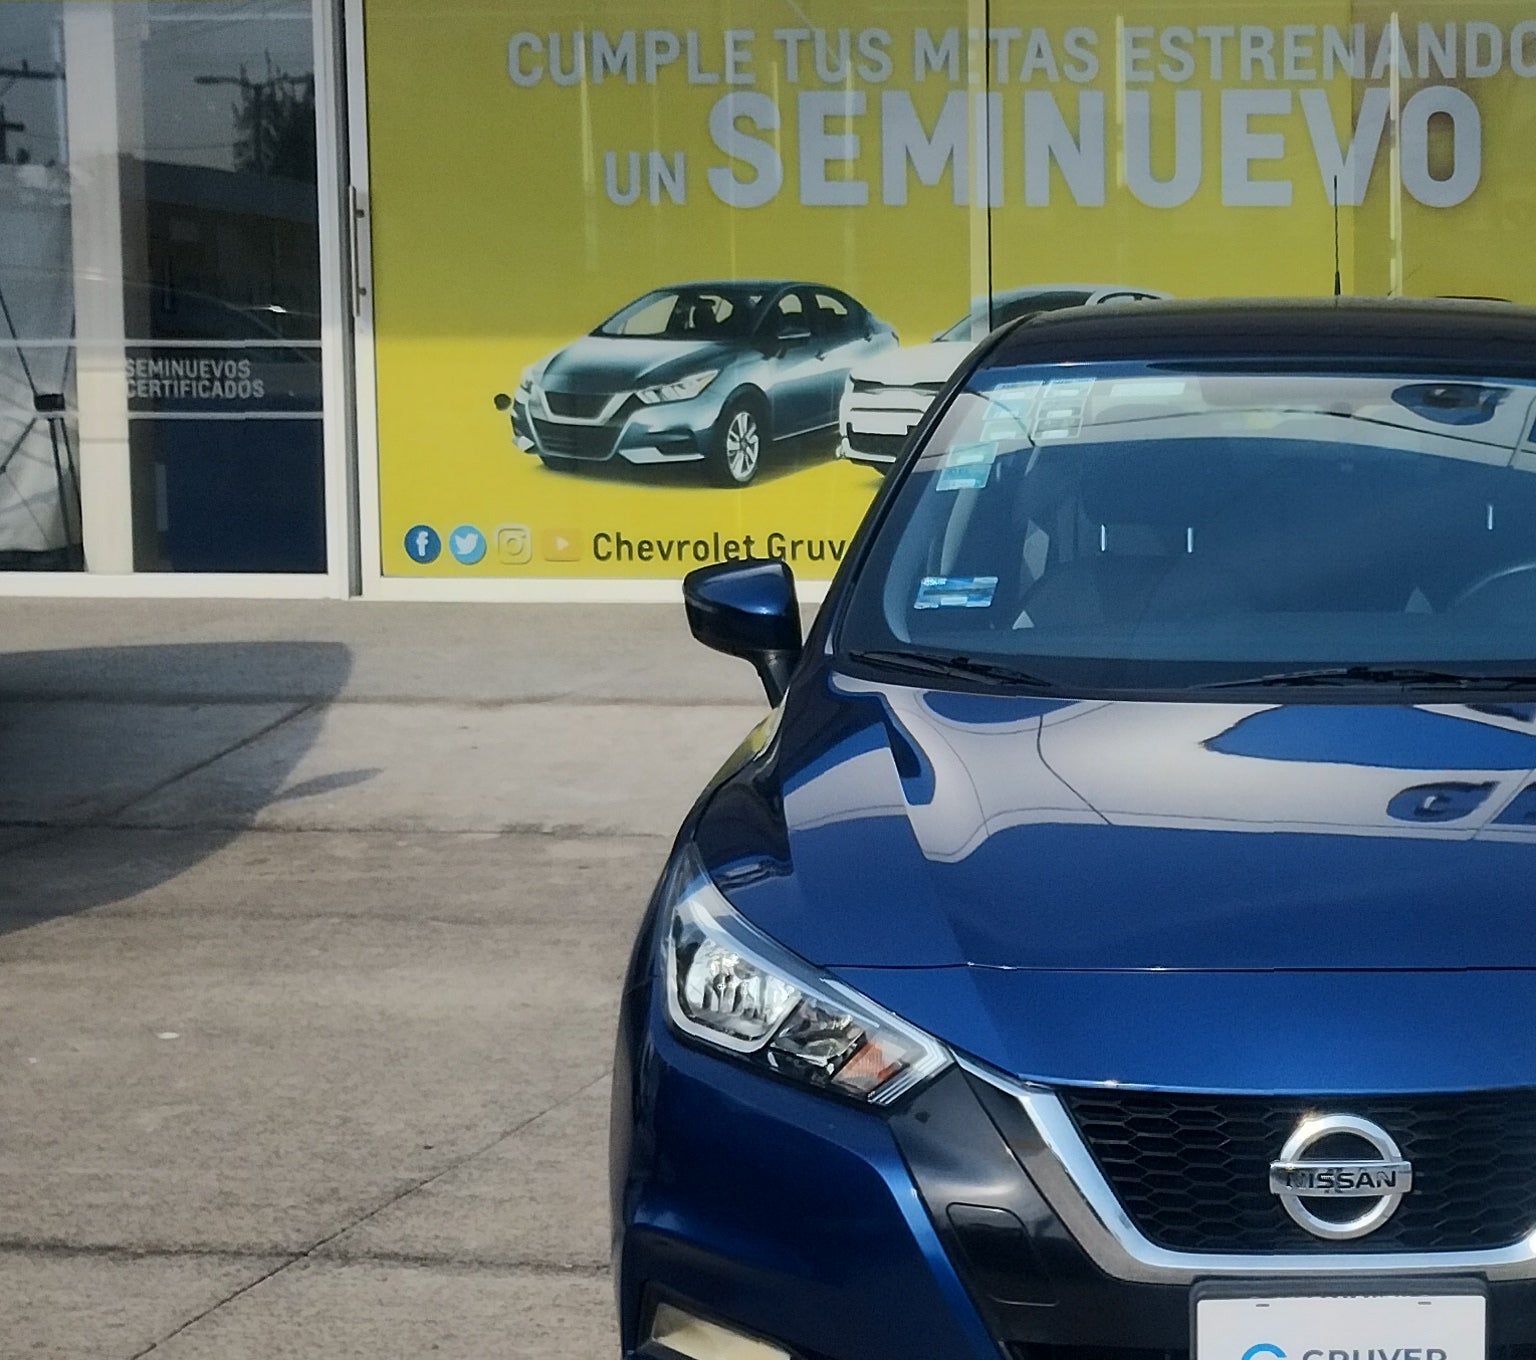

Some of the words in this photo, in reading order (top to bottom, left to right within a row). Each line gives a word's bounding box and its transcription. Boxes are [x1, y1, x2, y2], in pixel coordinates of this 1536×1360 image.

[507, 28, 756, 87] CUMPLE
[774, 27, 893, 84] TUS
[604, 150, 687, 207] UN
[706, 85, 1483, 209] SEMINUEVO
[124, 358, 251, 379] SEMINUEVOS
[127, 379, 265, 399] CERTIFICADOS
[592, 532, 756, 561] Chevrolet
[1285, 1170, 1397, 1189] NISSAN
